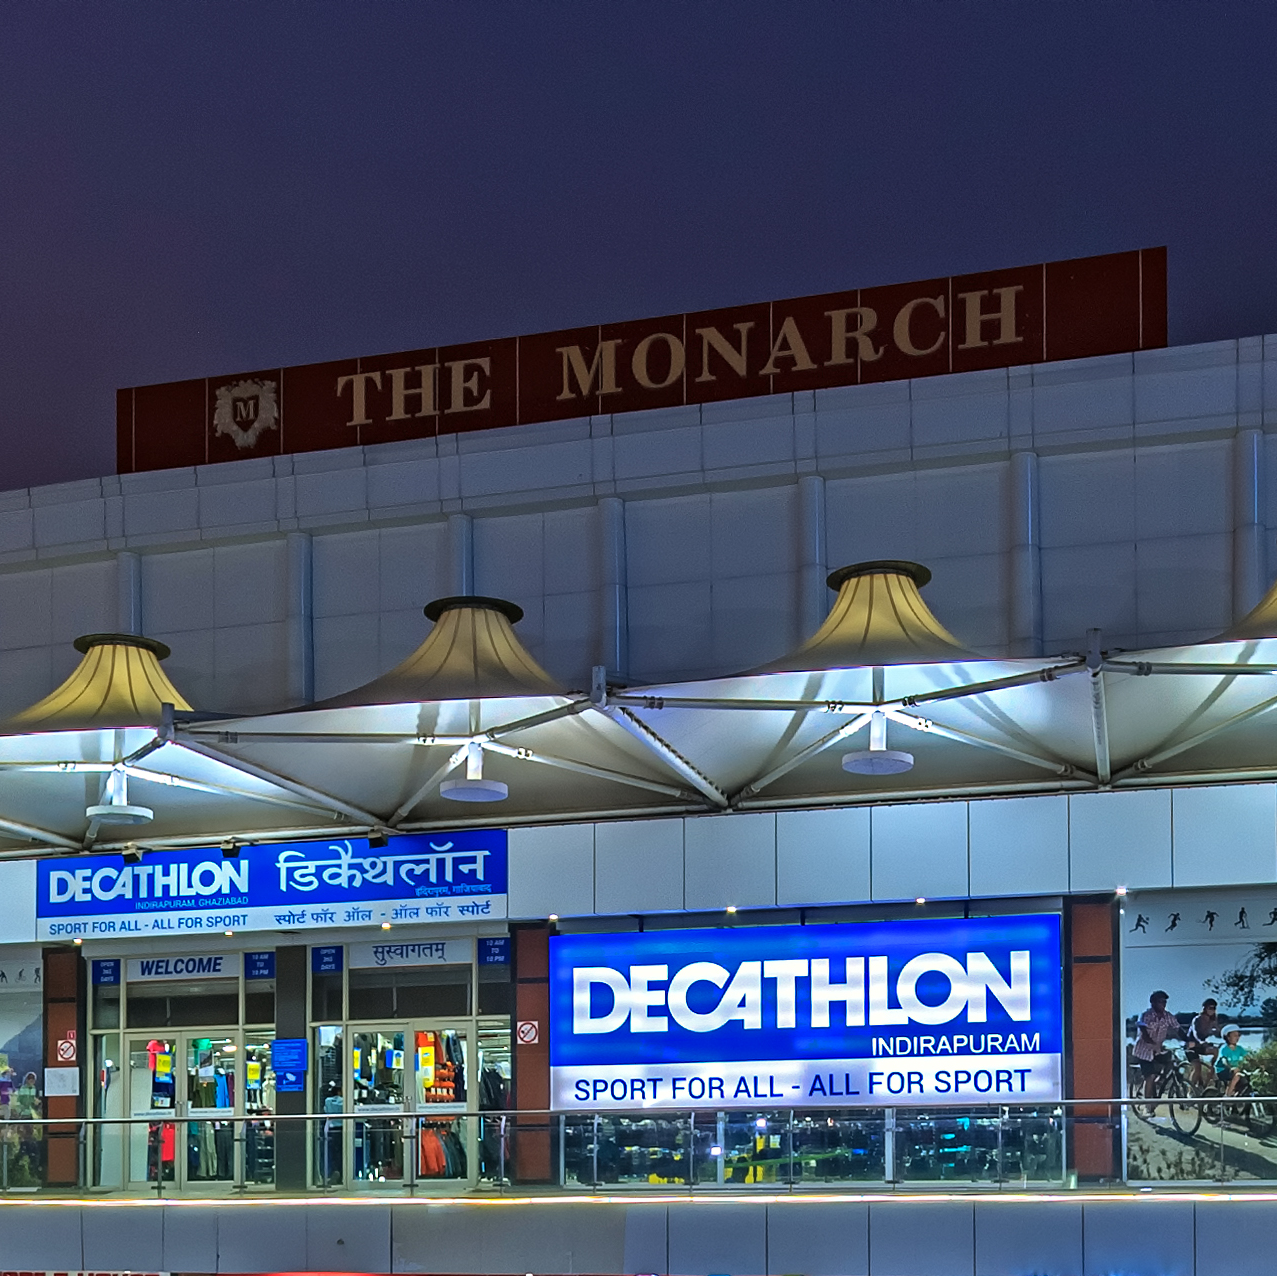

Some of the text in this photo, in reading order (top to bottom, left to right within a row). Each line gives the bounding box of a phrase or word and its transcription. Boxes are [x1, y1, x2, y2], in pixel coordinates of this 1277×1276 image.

[336, 285, 1025, 428] THE MONARCH
[275, 839, 492, 893] डिकैथलॉन
[48, 859, 250, 904] DECATHLON
[198, 896, 250, 908] GHAZIABAD
[273, 909, 307, 926] स्पोर्ट
[310, 907, 337, 924] फॉर
[343, 907, 373, 922] ऑल
[390, 904, 421, 920] ऑल
[425, 902, 452, 918] फॉर
[456, 900, 493, 917] स्पोर्ट
[48, 921, 89, 936] SPORT
[92, 920, 116, 934] FOR
[120, 919, 142, 932] ALL
[151, 917, 175, 931] ALL
[177, 916, 203, 929] FOR
[205, 914, 249, 928] SPORT
[140, 956, 224, 977] WELCOME
[372, 941, 447, 966] सुस्वागतम्
[571, 949, 1031, 1036] DECATHLON
[870, 1031, 1041, 1057] INDIRAPURAM
[573, 1077, 663, 1102] SPORT
[671, 1075, 724, 1100] FOR
[732, 1074, 784, 1099] ALL
[807, 1072, 860, 1097] ALL
[868, 1070, 925, 1095] FOR
[934, 1067, 1033, 1094] SPORT
